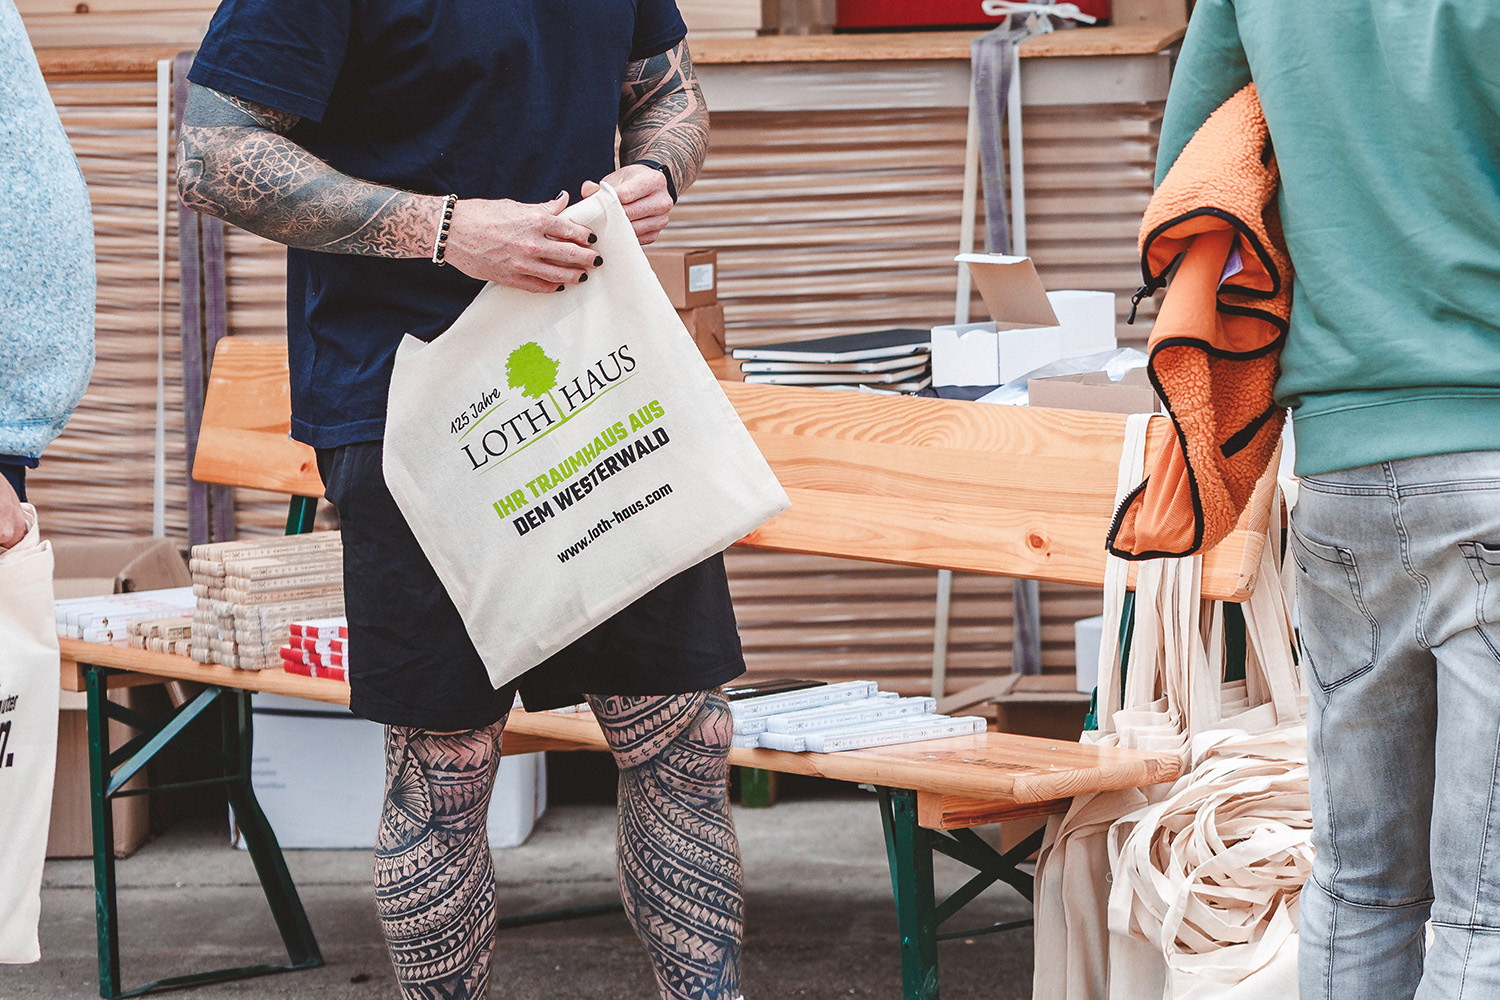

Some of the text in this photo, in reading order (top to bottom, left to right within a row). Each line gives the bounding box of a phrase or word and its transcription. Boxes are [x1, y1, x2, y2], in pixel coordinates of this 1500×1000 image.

[450, 387, 501, 434] 125 Jahre
[460, 344, 637, 471] LOTH HAUS
[492, 399, 665, 520] IHR TRAUMHAUS AUS
[512, 426, 671, 537] DEM WESTERWALD
[556, 482, 674, 564] www.loth-haus.com
